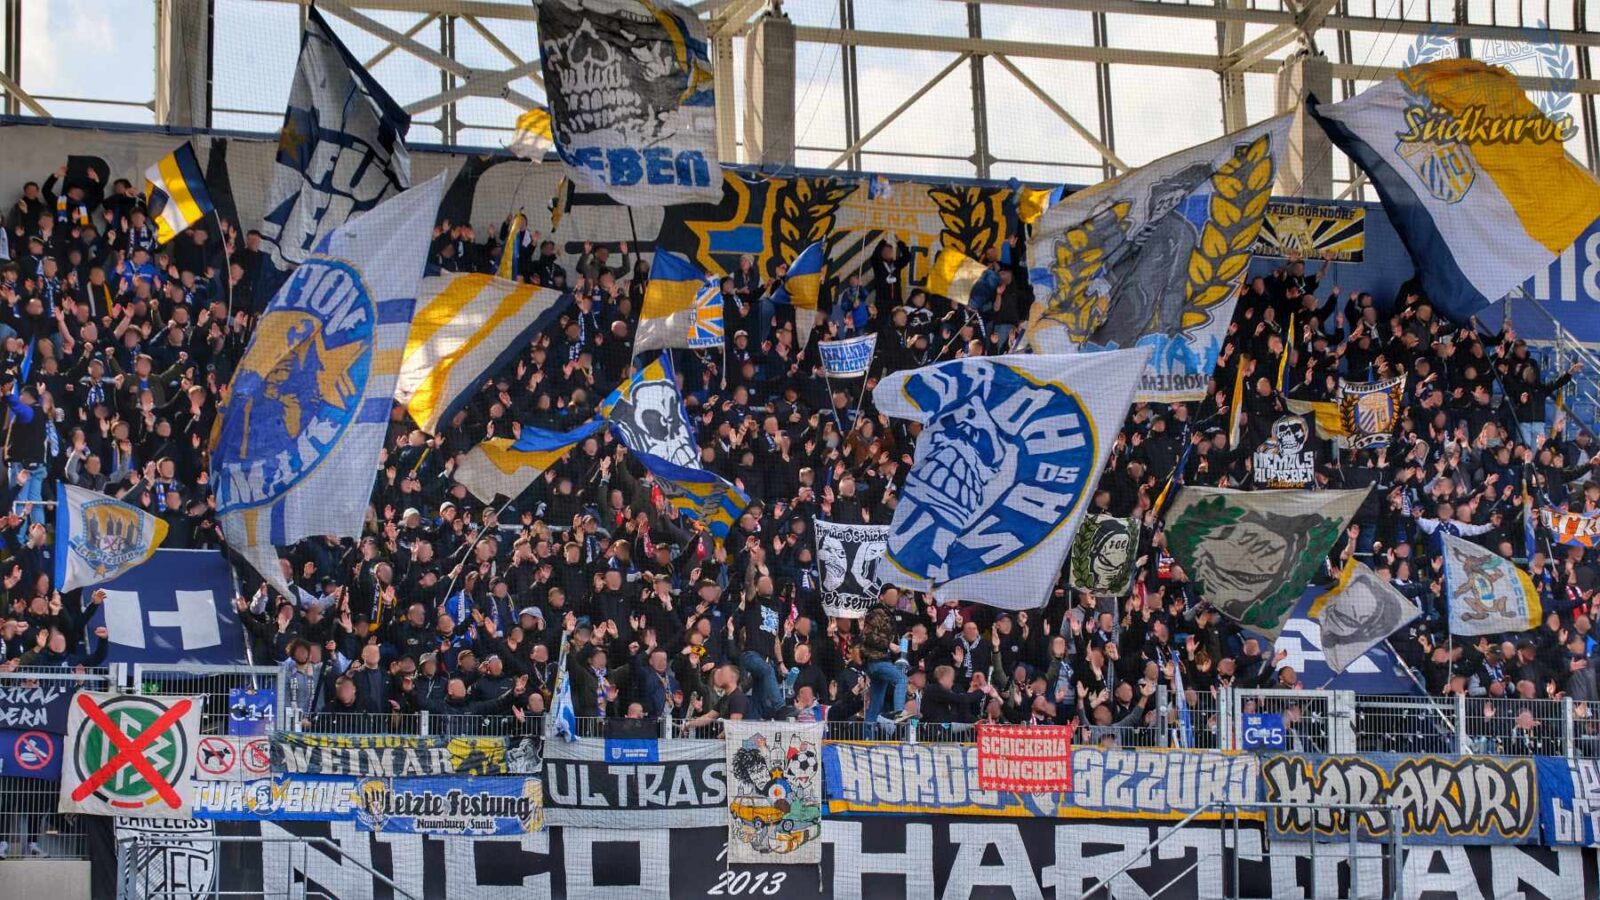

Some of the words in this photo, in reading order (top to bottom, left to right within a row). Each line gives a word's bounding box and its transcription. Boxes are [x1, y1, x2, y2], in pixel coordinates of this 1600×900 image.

[1254, 451, 1314, 470] NIEMALS
[981, 738, 1067, 757] SCHICKERIA
[283, 747, 456, 777] WEIMAR
[982, 757, 1067, 781] MÜNCHEN
[547, 763, 727, 807] ULTRAS
[707, 870, 787, 897] 2013
